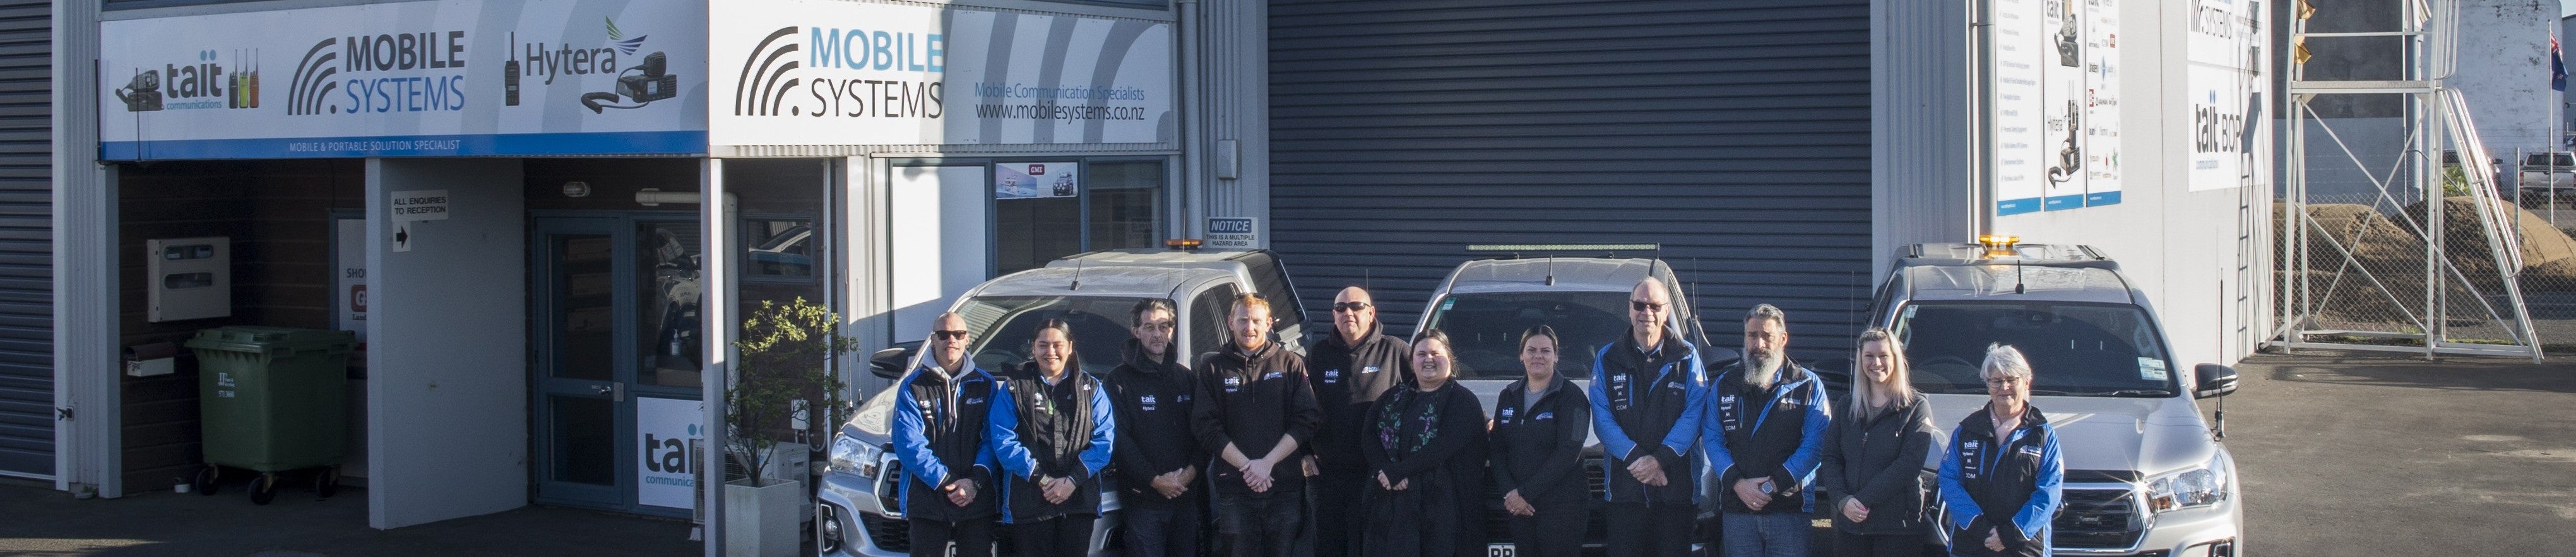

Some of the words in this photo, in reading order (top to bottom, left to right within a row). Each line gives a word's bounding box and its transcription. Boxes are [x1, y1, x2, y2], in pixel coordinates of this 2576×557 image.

[347, 31, 465, 72] MOBILE
[810, 26, 943, 73] MOBILE
[526, 42, 616, 85] Hytera
[347, 75, 465, 114] SYSTEMS
[811, 78, 942, 119] SYSTEMS
[975, 82, 1012, 98] Mobile
[1014, 83, 1094, 100] Communication
[1097, 86, 1145, 101] Specialists
[167, 99, 222, 110] communications
[976, 100, 1145, 124] www.mobilesystems.co.nz
[290, 143, 318, 152] MOBILE
[320, 142, 326, 151] &
[329, 141, 367, 151] PORTABLE
[371, 141, 411, 151] SOLUTION
[414, 139, 460, 150] SPECIALIST
[409, 197, 446, 205] ENQUIRIES
[407, 206, 446, 214] RECEPTION
[1211, 221, 1250, 232] NOTICE
[347, 268, 367, 278] SHO
[646, 476, 694, 488] communica
